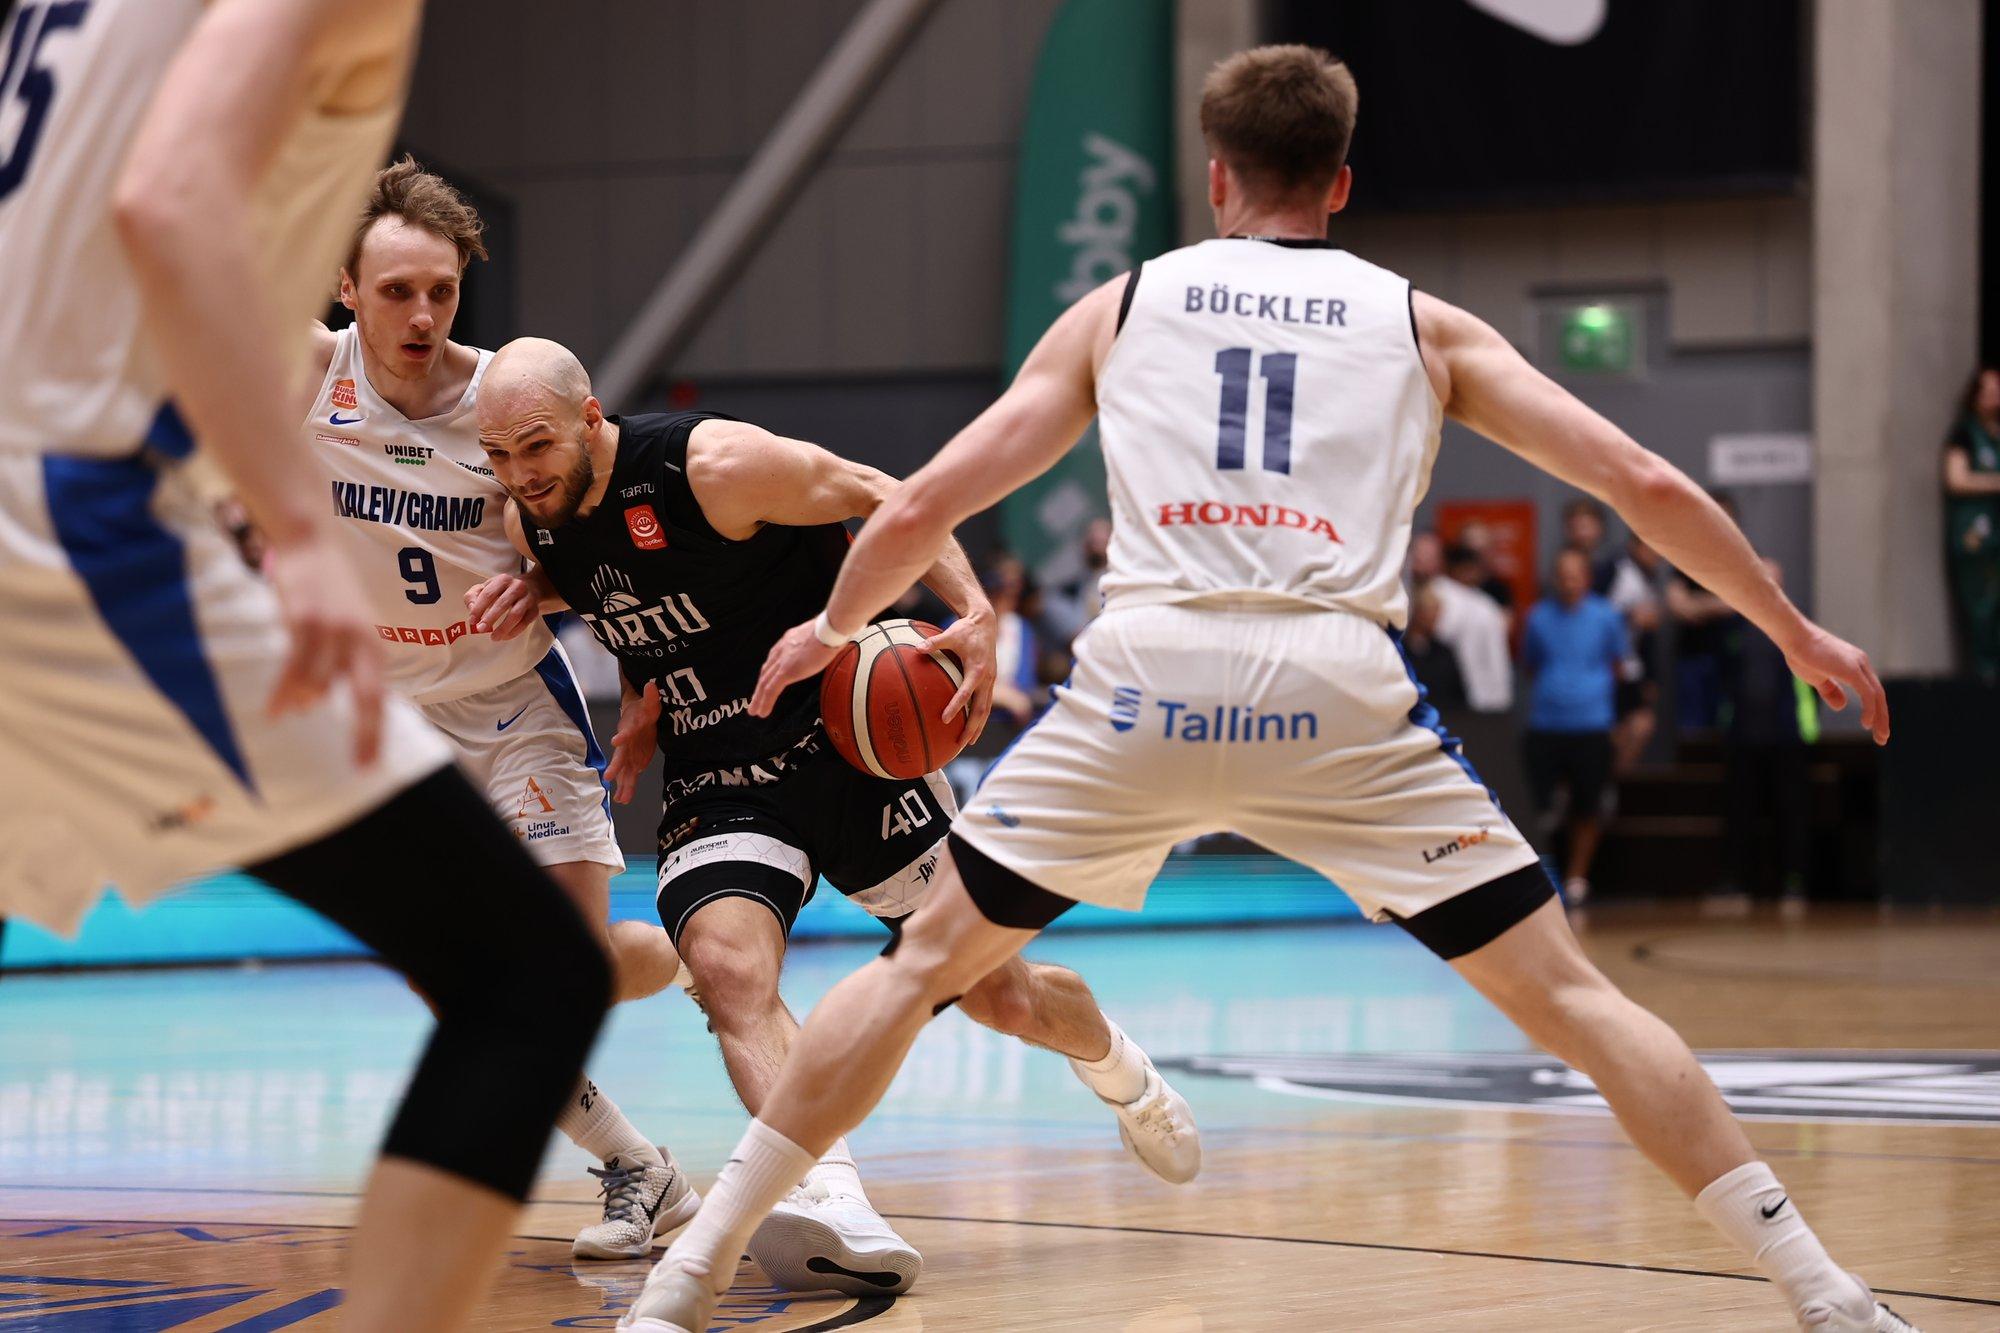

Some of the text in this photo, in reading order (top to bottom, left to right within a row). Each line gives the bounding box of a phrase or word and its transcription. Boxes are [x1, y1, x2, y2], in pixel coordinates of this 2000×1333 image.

[1055, 131, 1157, 302] bby
[1185, 283, 1347, 327] BÖCKLER
[1215, 347, 1297, 476] 11
[384, 444, 435, 459] UNIBET
[331, 480, 485, 532] KALEV/CRAMO
[1157, 501, 1344, 545] HONDA
[397, 547, 442, 605] 9
[378, 622, 478, 645] CRAM
[579, 592, 711, 650] TARTU
[1156, 699, 1318, 743] Tallinn
[527, 820, 556, 832] Linus
[528, 826, 570, 841] Medical
[881, 788, 933, 841] 40
